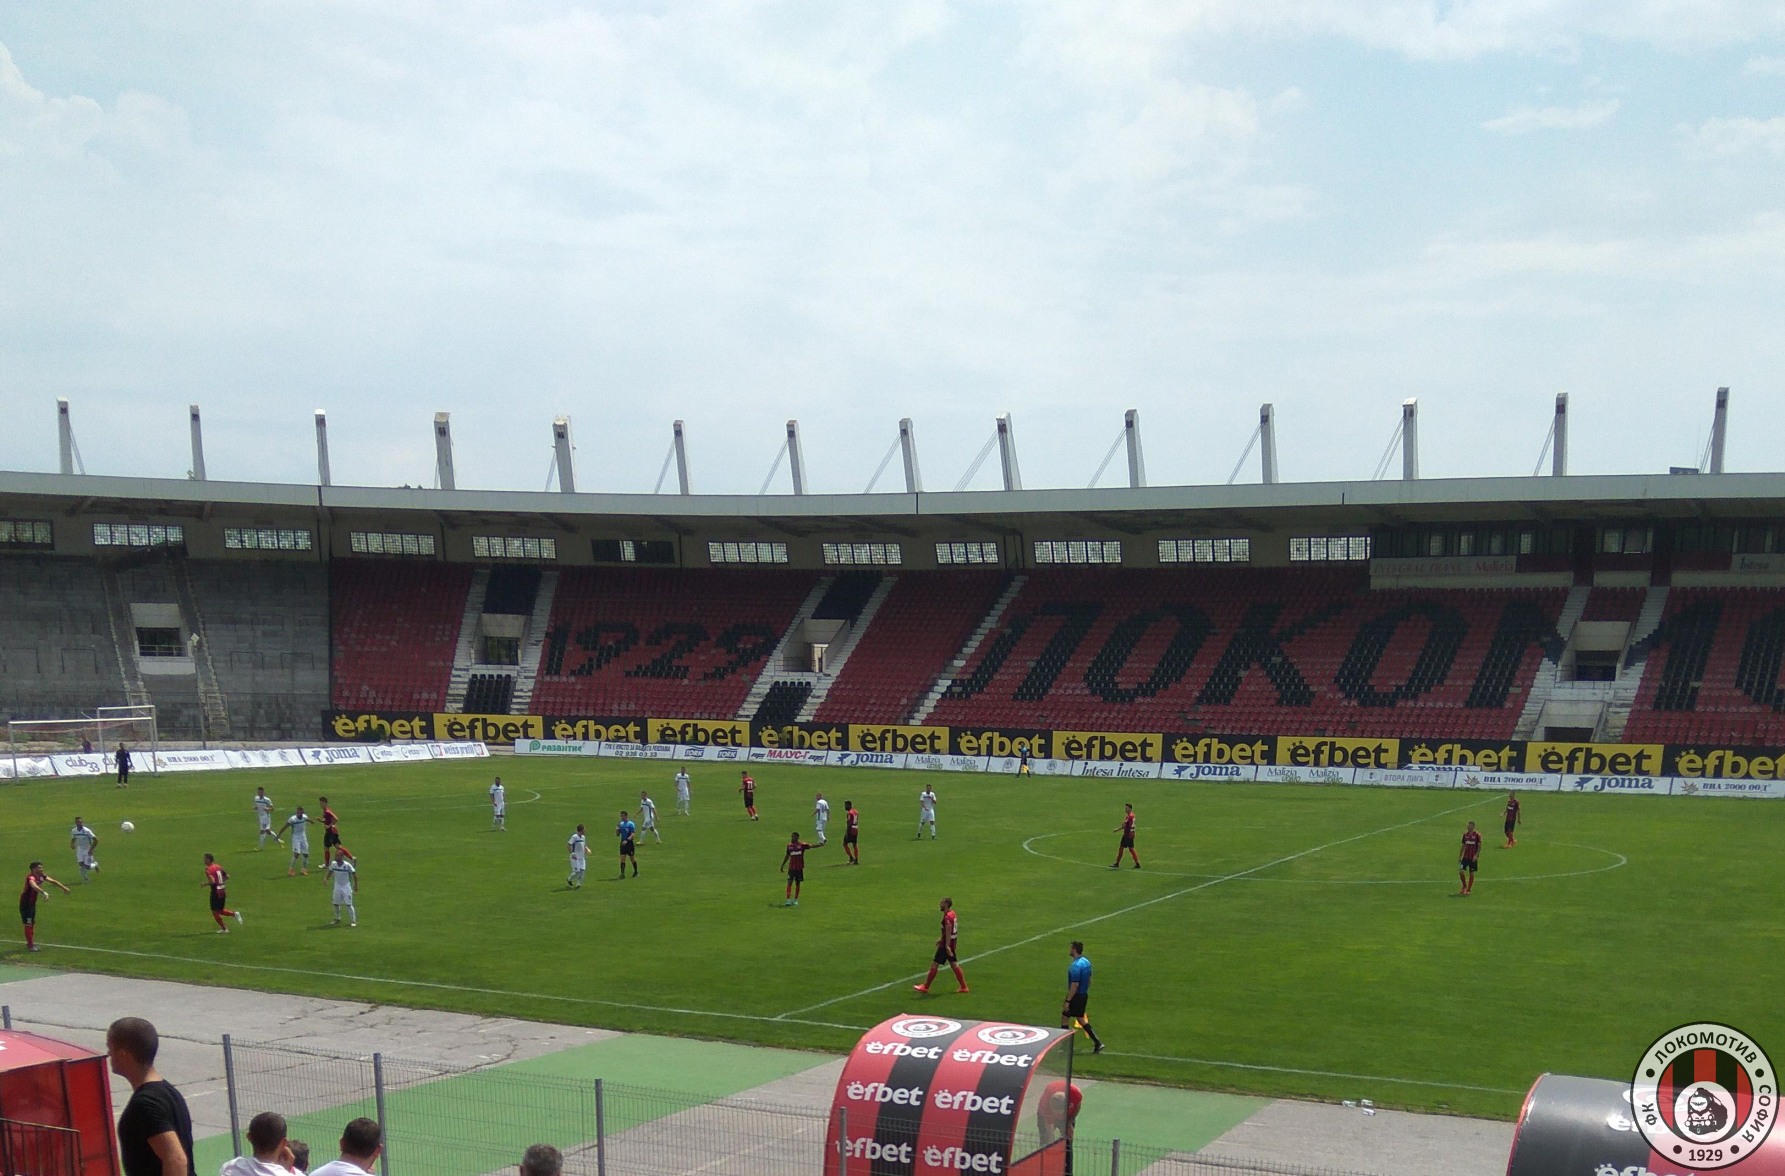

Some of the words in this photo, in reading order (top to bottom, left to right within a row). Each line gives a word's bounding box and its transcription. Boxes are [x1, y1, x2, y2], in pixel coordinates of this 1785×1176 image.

[545, 621, 783, 680] 1929
[446, 717, 535, 741] efbet
[554, 719, 641, 742] efbet
[660, 722, 743, 747] efbet
[761, 725, 842, 750] efbet
[860, 728, 941, 753] efbet
[960, 731, 1045, 758] efbet
[1065, 736, 1153, 762] efbet
[1174, 738, 1269, 763] efbet
[1290, 741, 1388, 768] efbet
[1411, 743, 1516, 771] efbet
[87, 762, 100, 772] 33
[915, 756, 941, 764] Malizia
[950, 757, 976, 766] Malizia
[1267, 767, 1298, 777] Malizia
[1541, 746, 1652, 776] efbet
[1309, 769, 1340, 779] Malizia
[1384, 775, 1405, 783] ВТОРА
[1406, 775, 1424, 783] ЛИГА
[866, 1042, 943, 1060] efbet
[952, 1049, 1032, 1068] efbet
[847, 1082, 924, 1106] efbet
[934, 1089, 1015, 1115] efbet
[924, 1145, 1004, 1174] efbet
